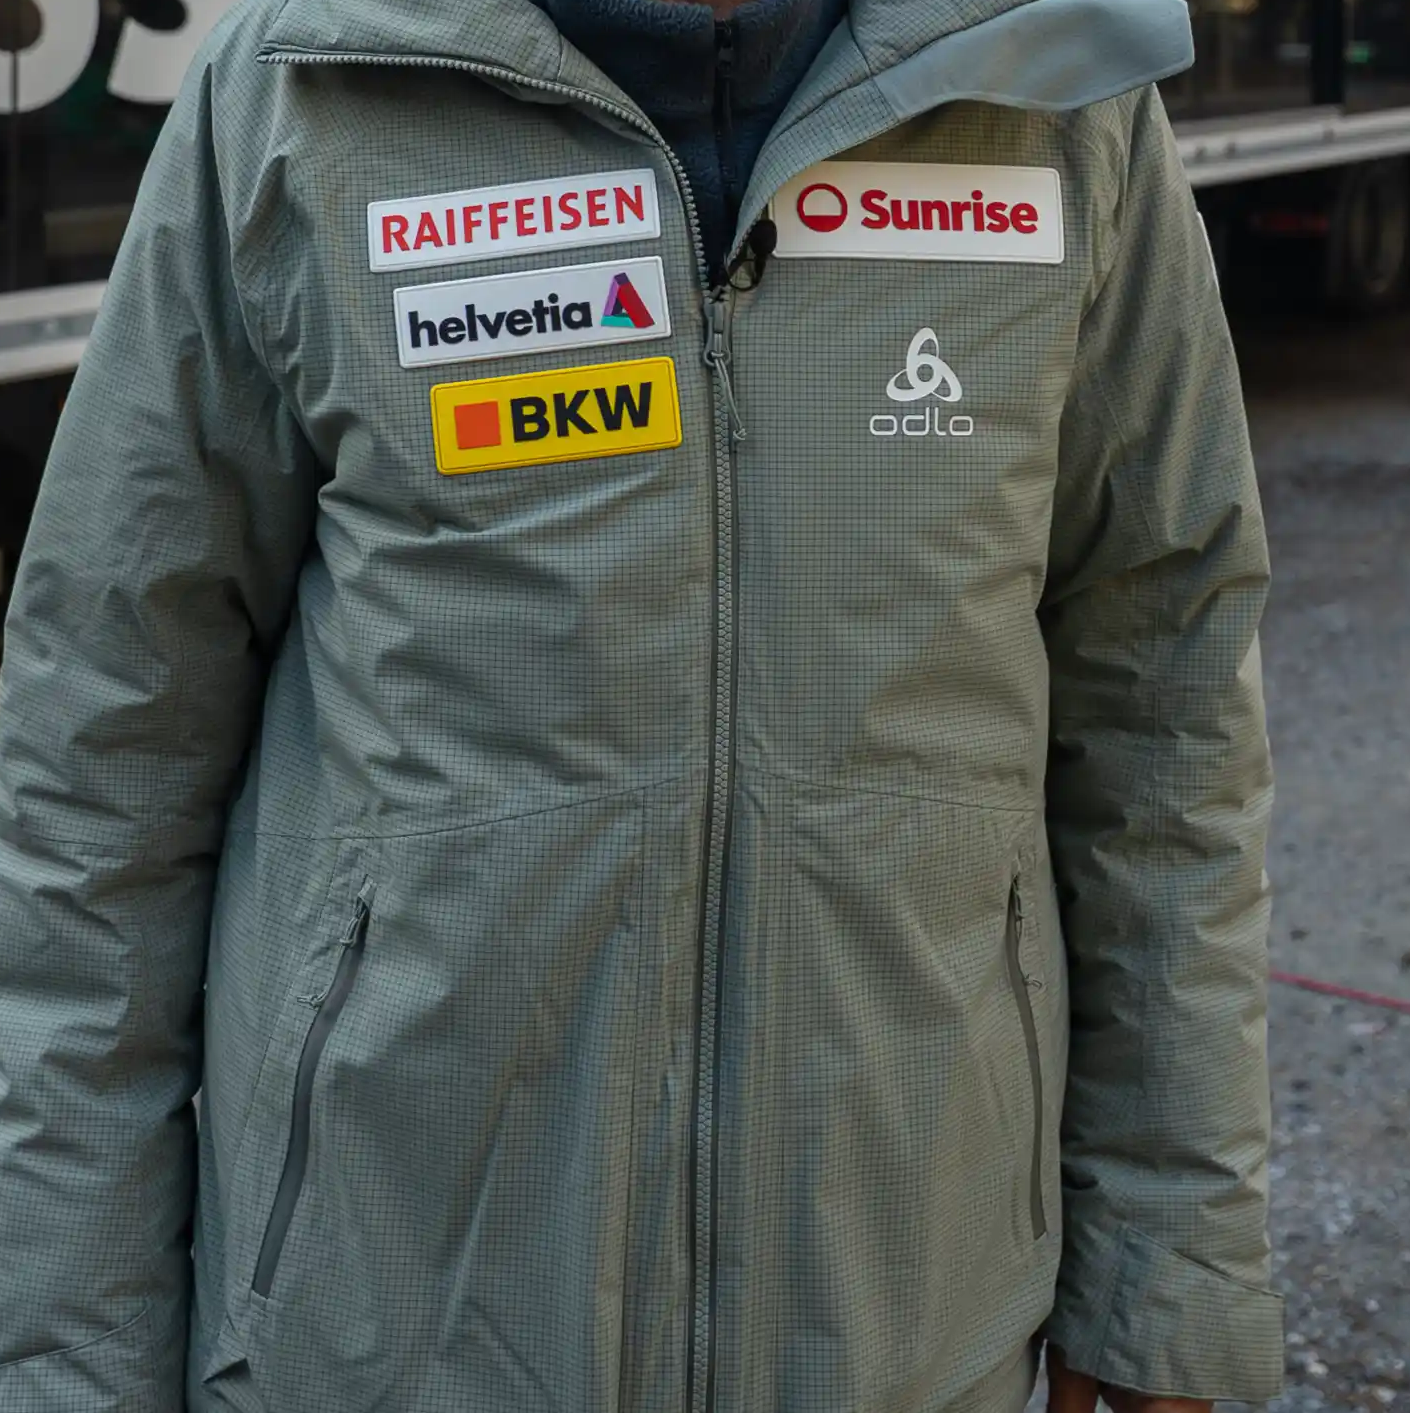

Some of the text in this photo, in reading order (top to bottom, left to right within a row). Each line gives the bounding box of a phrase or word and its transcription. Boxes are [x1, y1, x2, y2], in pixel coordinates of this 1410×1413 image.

[381, 184, 646, 254] RAIFFEISEN
[860, 189, 1039, 234] Sunrise
[408, 293, 593, 349] helvetia
[511, 381, 653, 443] BKW
[869, 406, 973, 435] odlo
